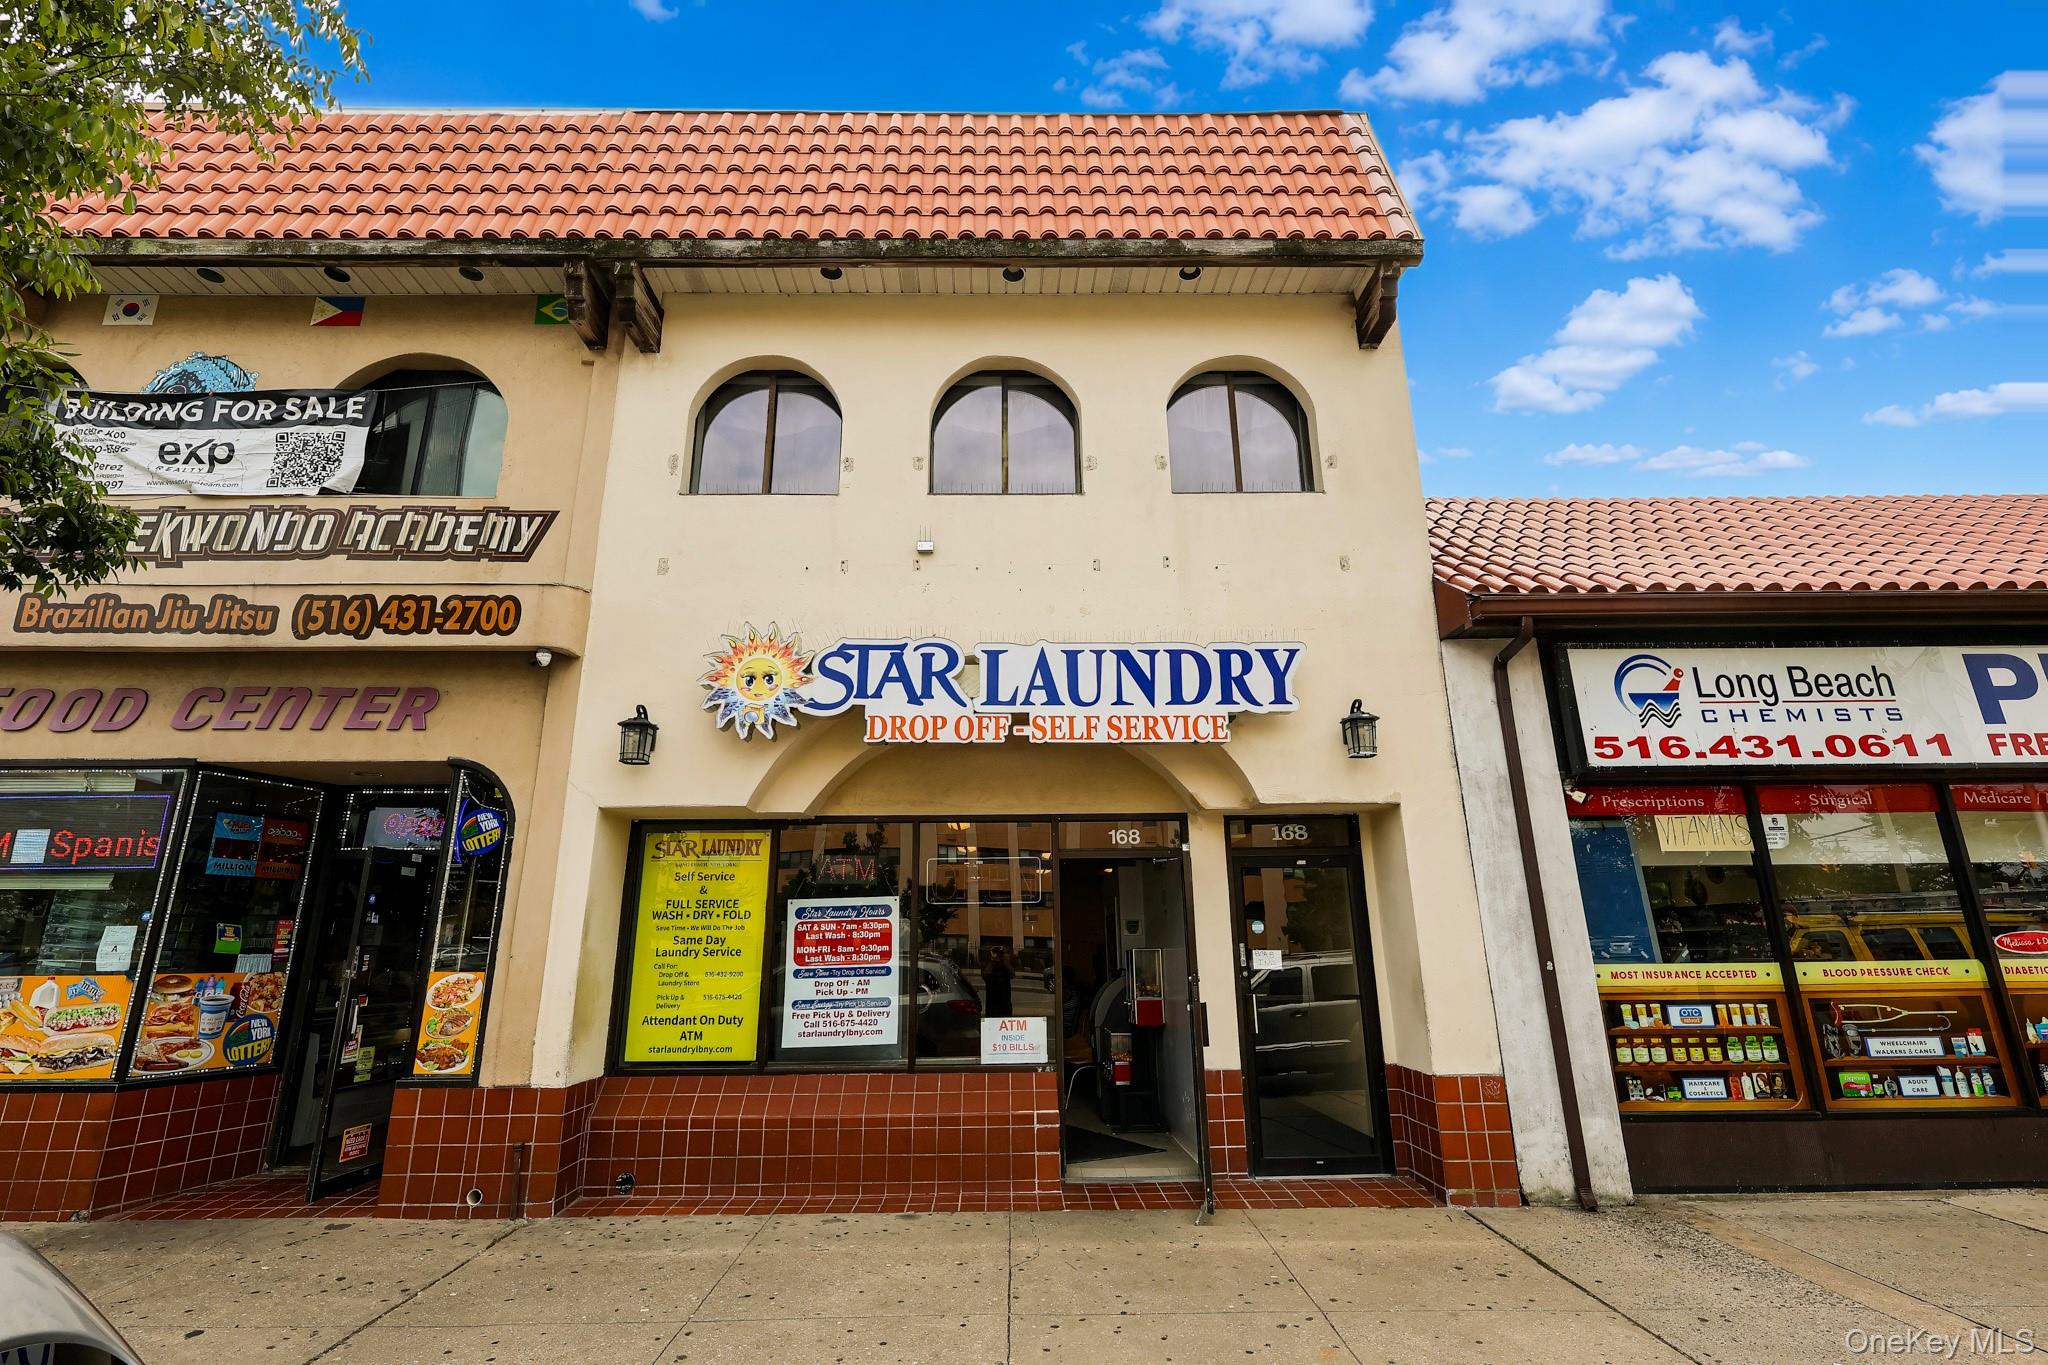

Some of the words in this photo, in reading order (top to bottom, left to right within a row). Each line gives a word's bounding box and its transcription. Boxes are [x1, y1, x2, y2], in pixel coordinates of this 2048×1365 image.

[64, 399, 204, 422] BUILDING
[212, 400, 277, 422] FOR
[282, 396, 366, 421] SALE
[94, 462, 123, 471] Perez
[105, 511, 335, 558] EKWONDO
[343, 511, 544, 553] ACADEMY
[19, 596, 149, 629] Brazilian
[156, 598, 198, 630] Jiu
[205, 598, 274, 631] Jitsu
[297, 599, 373, 635] (516)
[380, 599, 516, 632] 431-2700
[805, 643, 961, 709] STAR
[979, 647, 1300, 708] LAUNDRY
[1692, 666, 1779, 707] Long
[1786, 665, 1897, 698] Beach
[170, 686, 441, 731] CENTER
[1700, 707, 1904, 723] CHEMISTS
[865, 715, 949, 743] DROP
[953, 714, 1011, 740] OFF
[1031, 714, 1101, 742] SELF
[1107, 714, 1230, 742] SERVICE
[1593, 733, 1953, 760] 516.431.0611
[1601, 794, 1705, 810] Prescriptions
[1809, 791, 1872, 809] Surgical
[1964, 791, 2031, 804] Medicare
[477, 812, 494, 822] NEW
[479, 819, 499, 831] YORK
[1656, 814, 1752, 846] VITAMINS
[1108, 829, 1141, 844] 168
[1271, 825, 1308, 841] 168
[651, 839, 700, 859] STAR
[701, 838, 763, 857] LAUNDRY
[213, 861, 252, 872] MILLION
[817, 857, 877, 880] ATM
[674, 872, 695, 881] Self
[697, 871, 735, 881] Service
[699, 885, 708, 895] &
[666, 900, 692, 909] FULL
[695, 899, 740, 909] SERVICE
[652, 911, 683, 920] WASH
[693, 911, 714, 920] DRY
[723, 910, 751, 920] FOLD
[802, 907, 822, 919] Star
[825, 906, 858, 918] Laundry
[860, 906, 886, 918] Hours
[820, 923, 836, 931] SUN
[862, 922, 890, 932] 9:30pm
[805, 932, 823, 940] Last
[824, 931, 846, 939] Wash
[673, 936, 703, 945] Same
[705, 936, 726, 947] Day
[2002, 936, 2034, 949] Melissa
[111, 944, 118, 953] A
[655, 947, 700, 959] Laundry
[702, 947, 742, 957] Service
[796, 946, 831, 954] MON-FRI
[861, 944, 889, 954] 9:30pm
[804, 954, 822, 962] Last
[824, 953, 845, 961] Wash
[852, 953, 881, 962] 8:30pm
[842, 969, 855, 977] Drop
[1610, 970, 1638, 980] MOST
[1642, 970, 1702, 979] INSURANCE
[1705, 970, 1758, 979] ACCEPTED
[1823, 968, 1858, 977] BLOOD
[1860, 967, 1913, 977] PRESSURE
[1915, 966, 1951, 976] CHECK
[814, 980, 834, 988] Drop
[836, 988, 848, 997] Up
[845, 1000, 857, 1008] Pick
[857, 1000, 866, 1008] Up
[792, 1012, 812, 1020] Free
[833, 1011, 845, 1020] Up
[847, 1010, 854, 1018] &
[856, 1010, 891, 1019] Delivery
[1681, 1008, 1700, 1017] OTC
[250, 1018, 268, 1028] NEW
[642, 1015, 697, 1026] Attendant
[699, 1015, 715, 1025] On
[717, 1015, 744, 1028] Duty
[803, 1020, 820, 1028] Call
[822, 1018, 879, 1028] 516-675-4420
[998, 1019, 1027, 1032] ATM
[251, 1027, 272, 1040] YORK
[680, 1031, 703, 1041] ATM
[797, 1028, 883, 1039] starlaundrylbny.com
[1001, 1034, 1025, 1042] INSIDE
[648, 1045, 733, 1055] starlaundrylbny.com
[992, 1043, 1007, 1052] $10
[1009, 1043, 1035, 1051] BILLS
